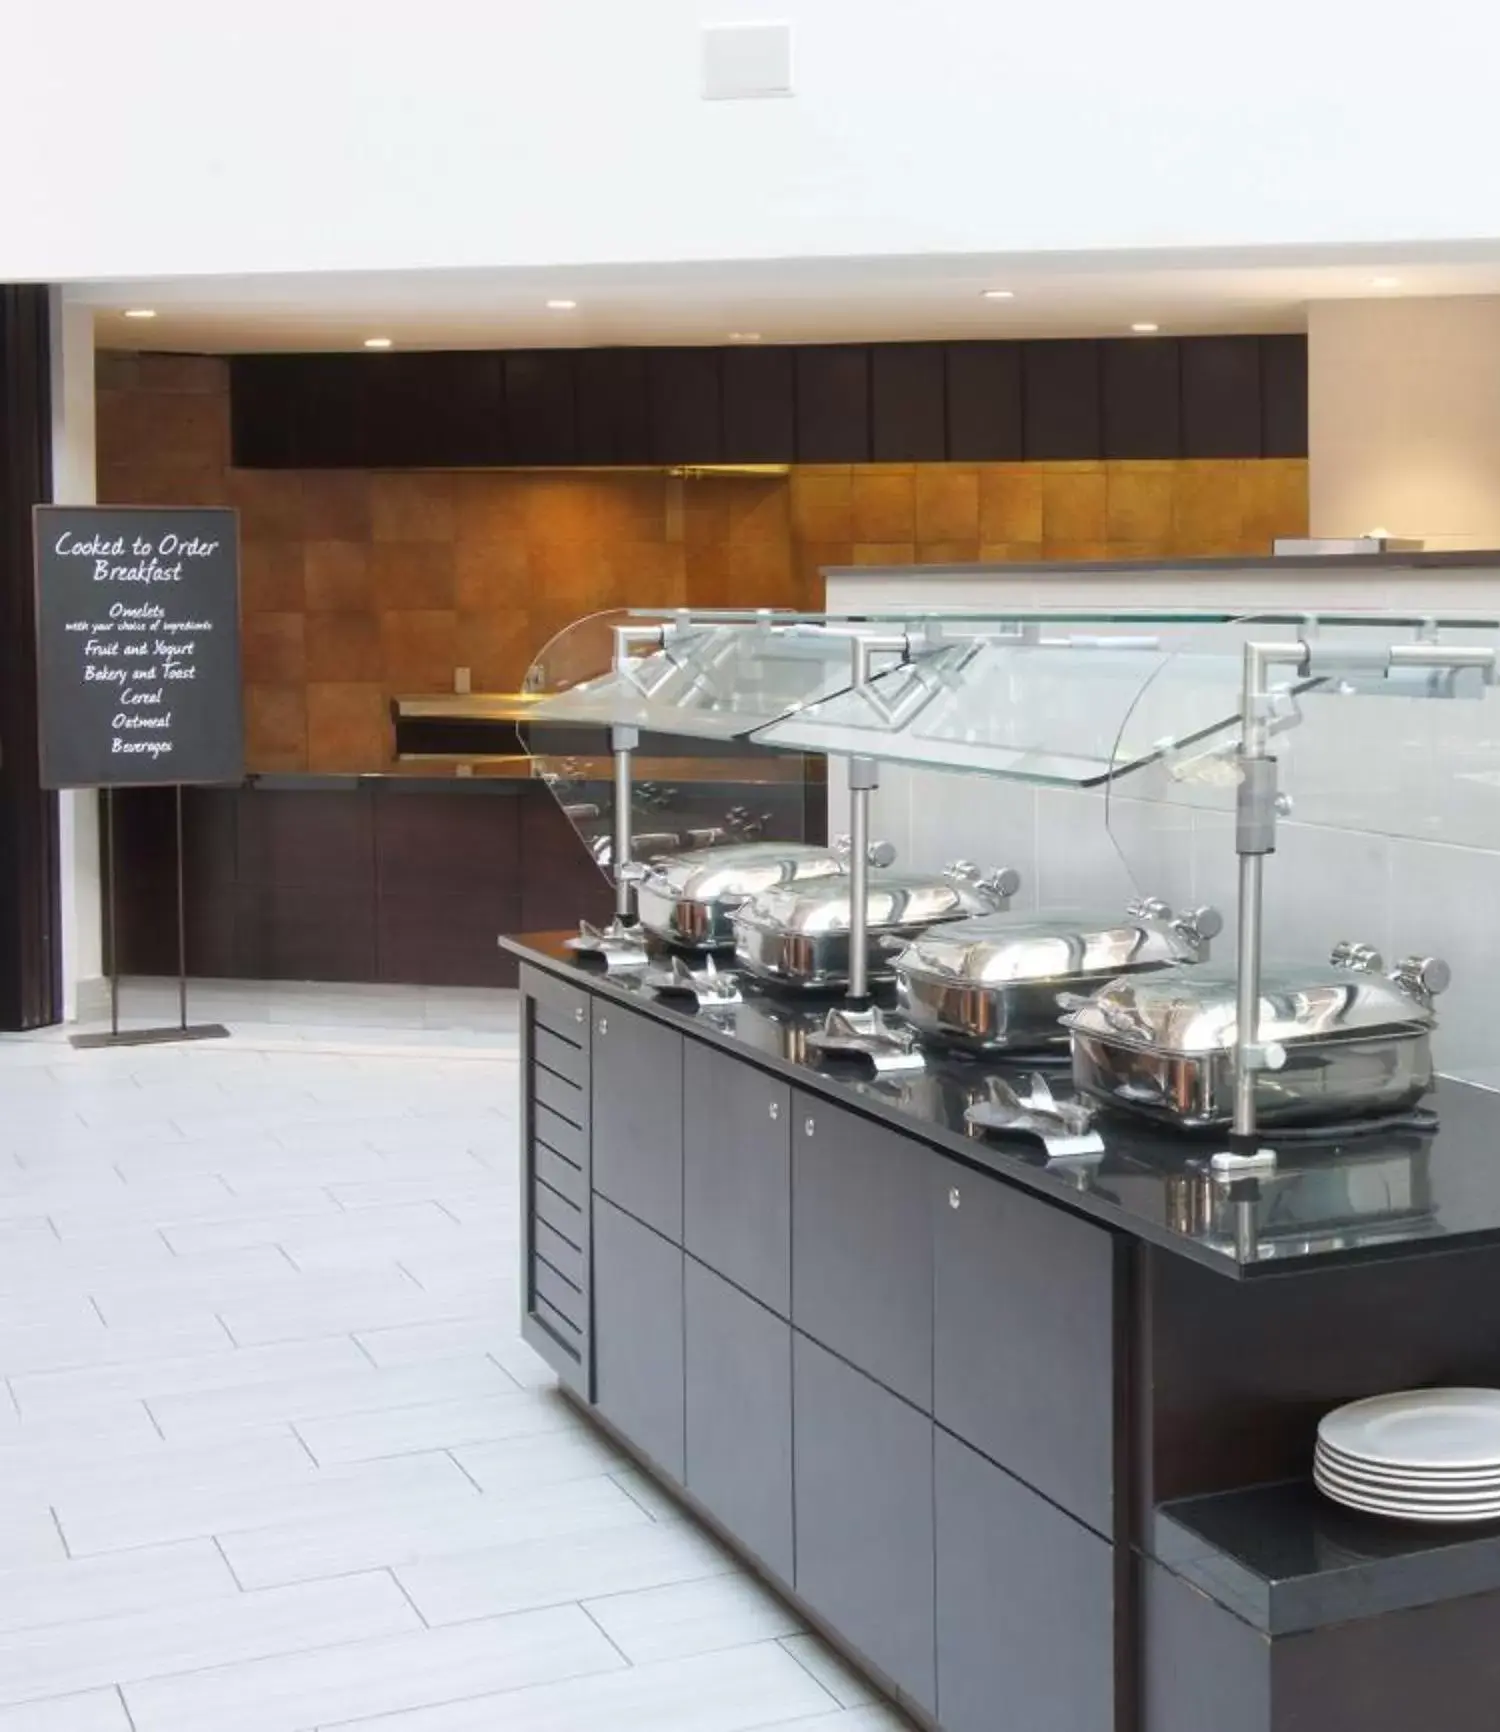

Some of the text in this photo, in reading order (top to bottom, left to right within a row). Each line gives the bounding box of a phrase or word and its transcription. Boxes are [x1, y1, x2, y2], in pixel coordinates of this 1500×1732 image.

[55, 531, 219, 557] Cooked to Order
[93, 557, 182, 585] Breakfast
[109, 602, 165, 619] Omelets
[65, 620, 213, 634] with your choice of ingredients
[84, 639, 195, 663] Fruit and Yogurt
[84, 661, 196, 685] Bakery and Toast
[120, 687, 163, 705] Cereal
[111, 712, 172, 729] Oatmeal
[111, 737, 173, 759] Beverages
